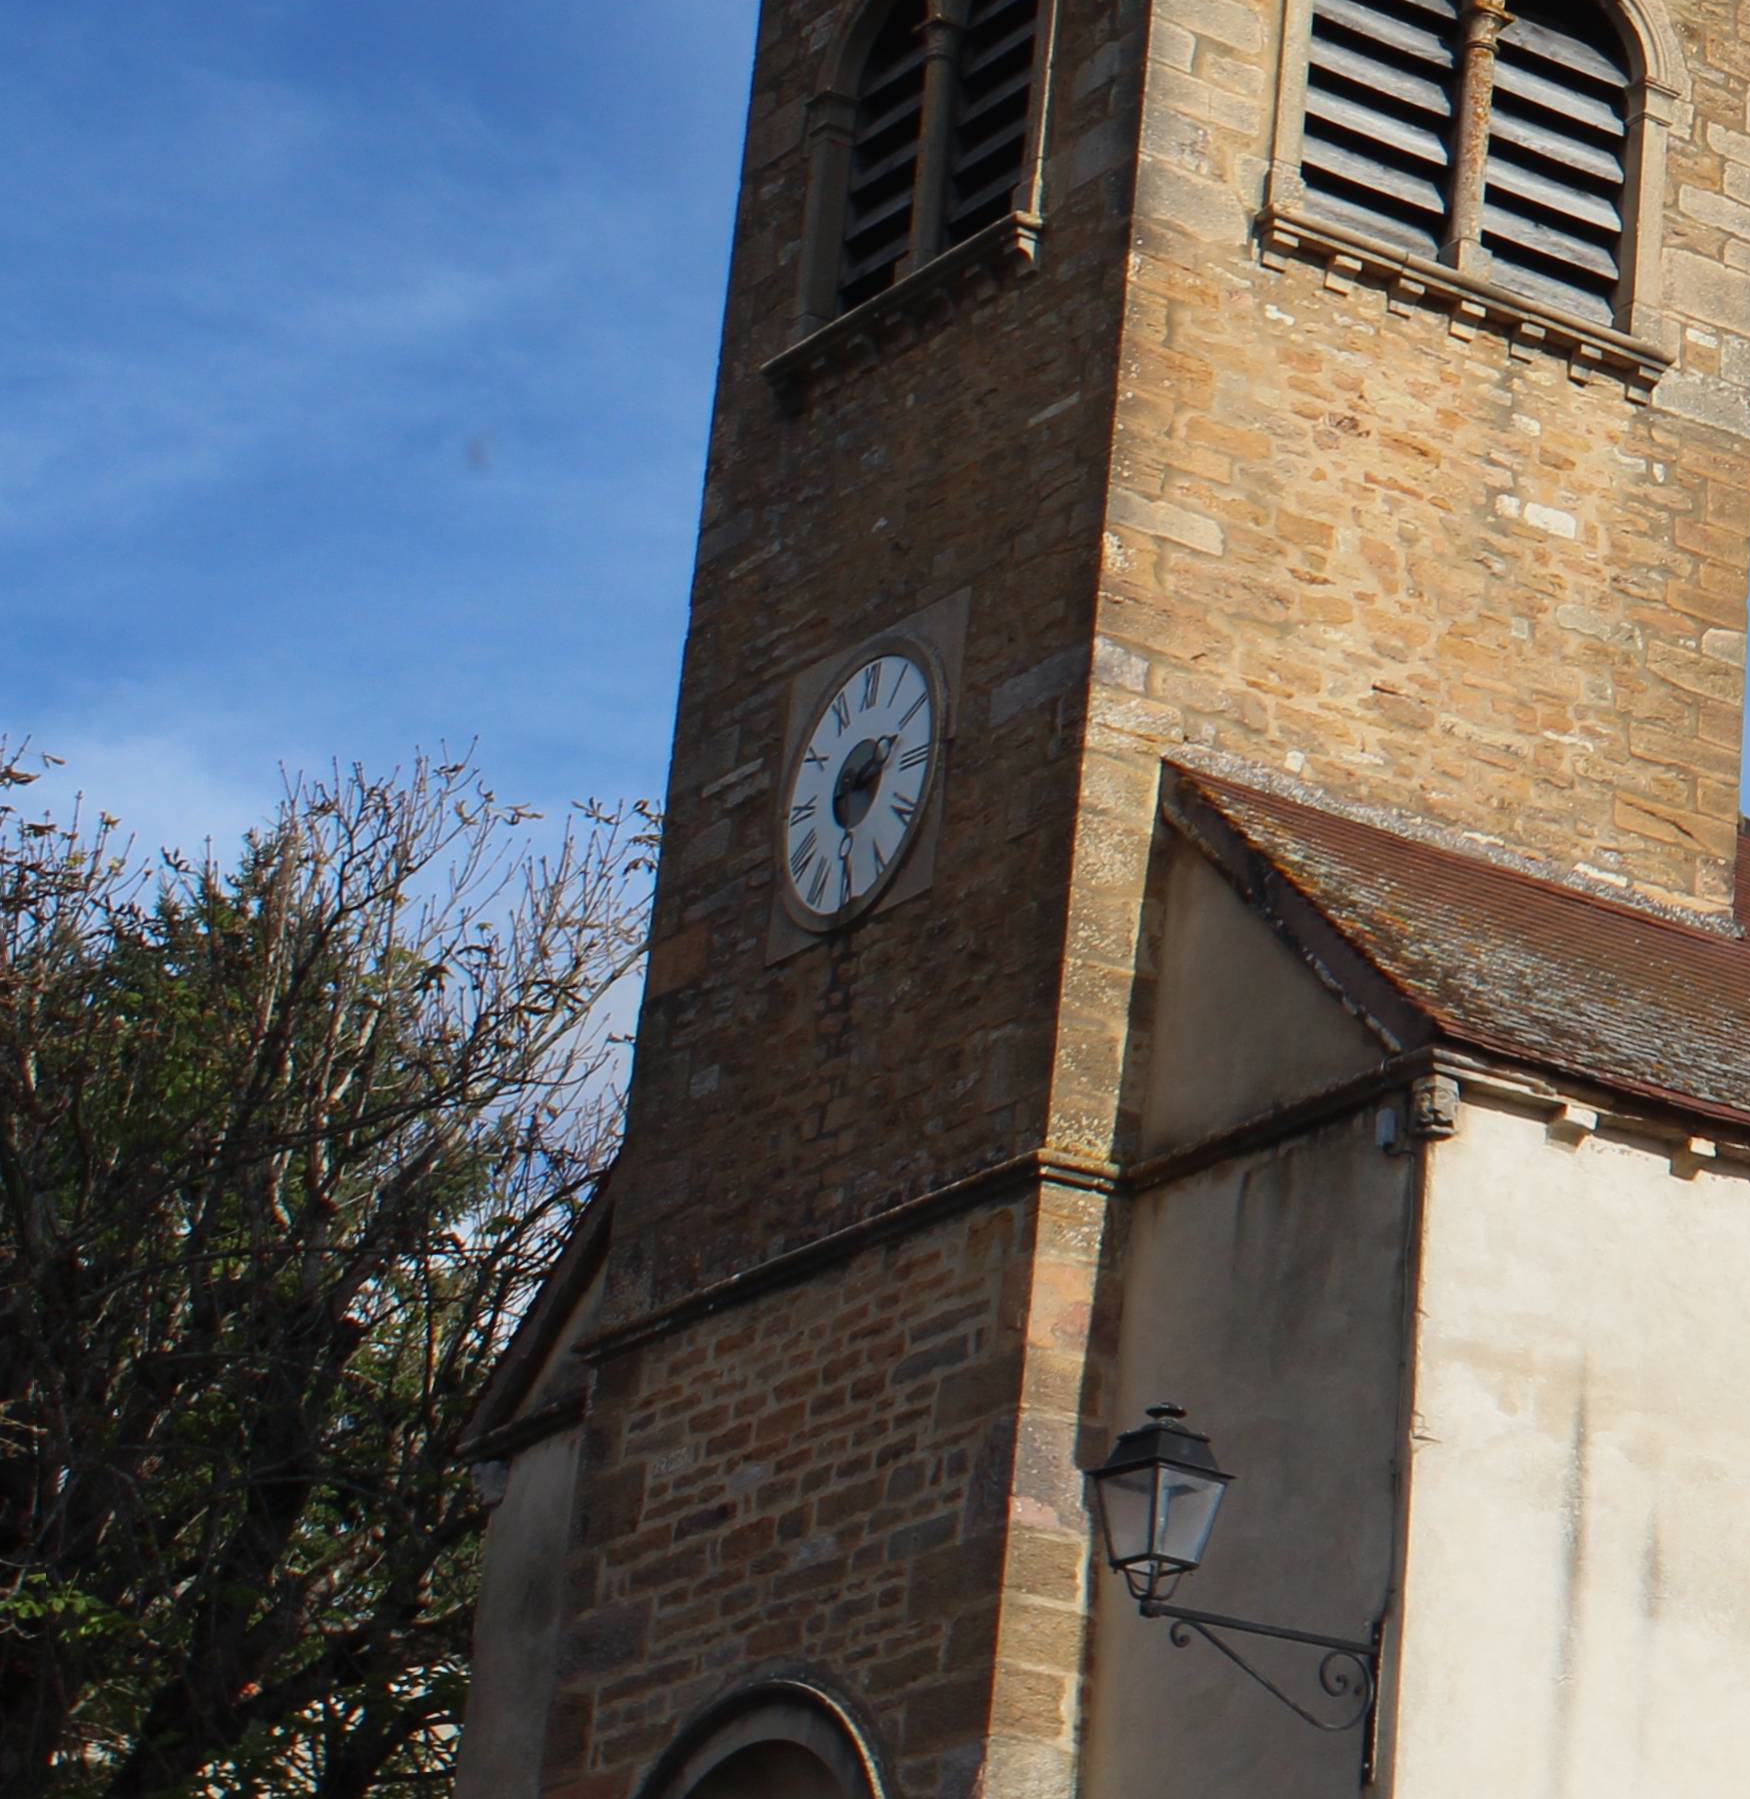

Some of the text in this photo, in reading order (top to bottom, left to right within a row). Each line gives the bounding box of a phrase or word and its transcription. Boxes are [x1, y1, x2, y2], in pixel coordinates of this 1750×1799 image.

[859, 662, 882, 712] XII
[832, 692, 850, 736] XI
[898, 691, 928, 731] II
[804, 746, 829, 772] X
[899, 743, 928, 771] III
[790, 794, 818, 827] IX
